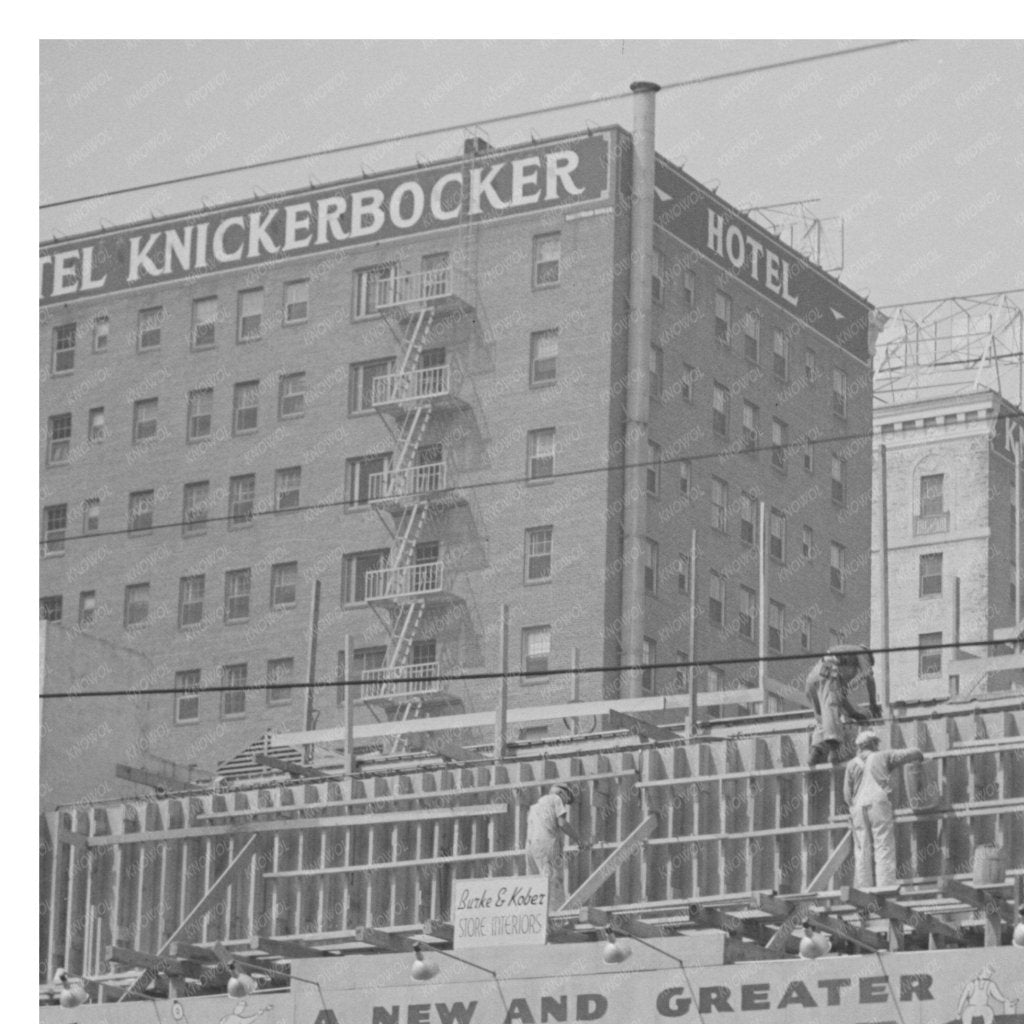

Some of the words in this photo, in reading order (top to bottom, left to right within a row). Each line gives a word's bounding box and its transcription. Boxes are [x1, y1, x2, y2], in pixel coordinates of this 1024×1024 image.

[126, 149, 586, 282] KNICKERBOCKER
[706, 208, 799, 307] HOTEL
[457, 889, 492, 909] Burke
[495, 887, 507, 907] &
[507, 886, 546, 906] Kober
[459, 917, 487, 938] STORE
[491, 914, 542, 937] INTERIORS
[503, 993, 608, 1024] AND
[656, 974, 934, 1017] GREATER
